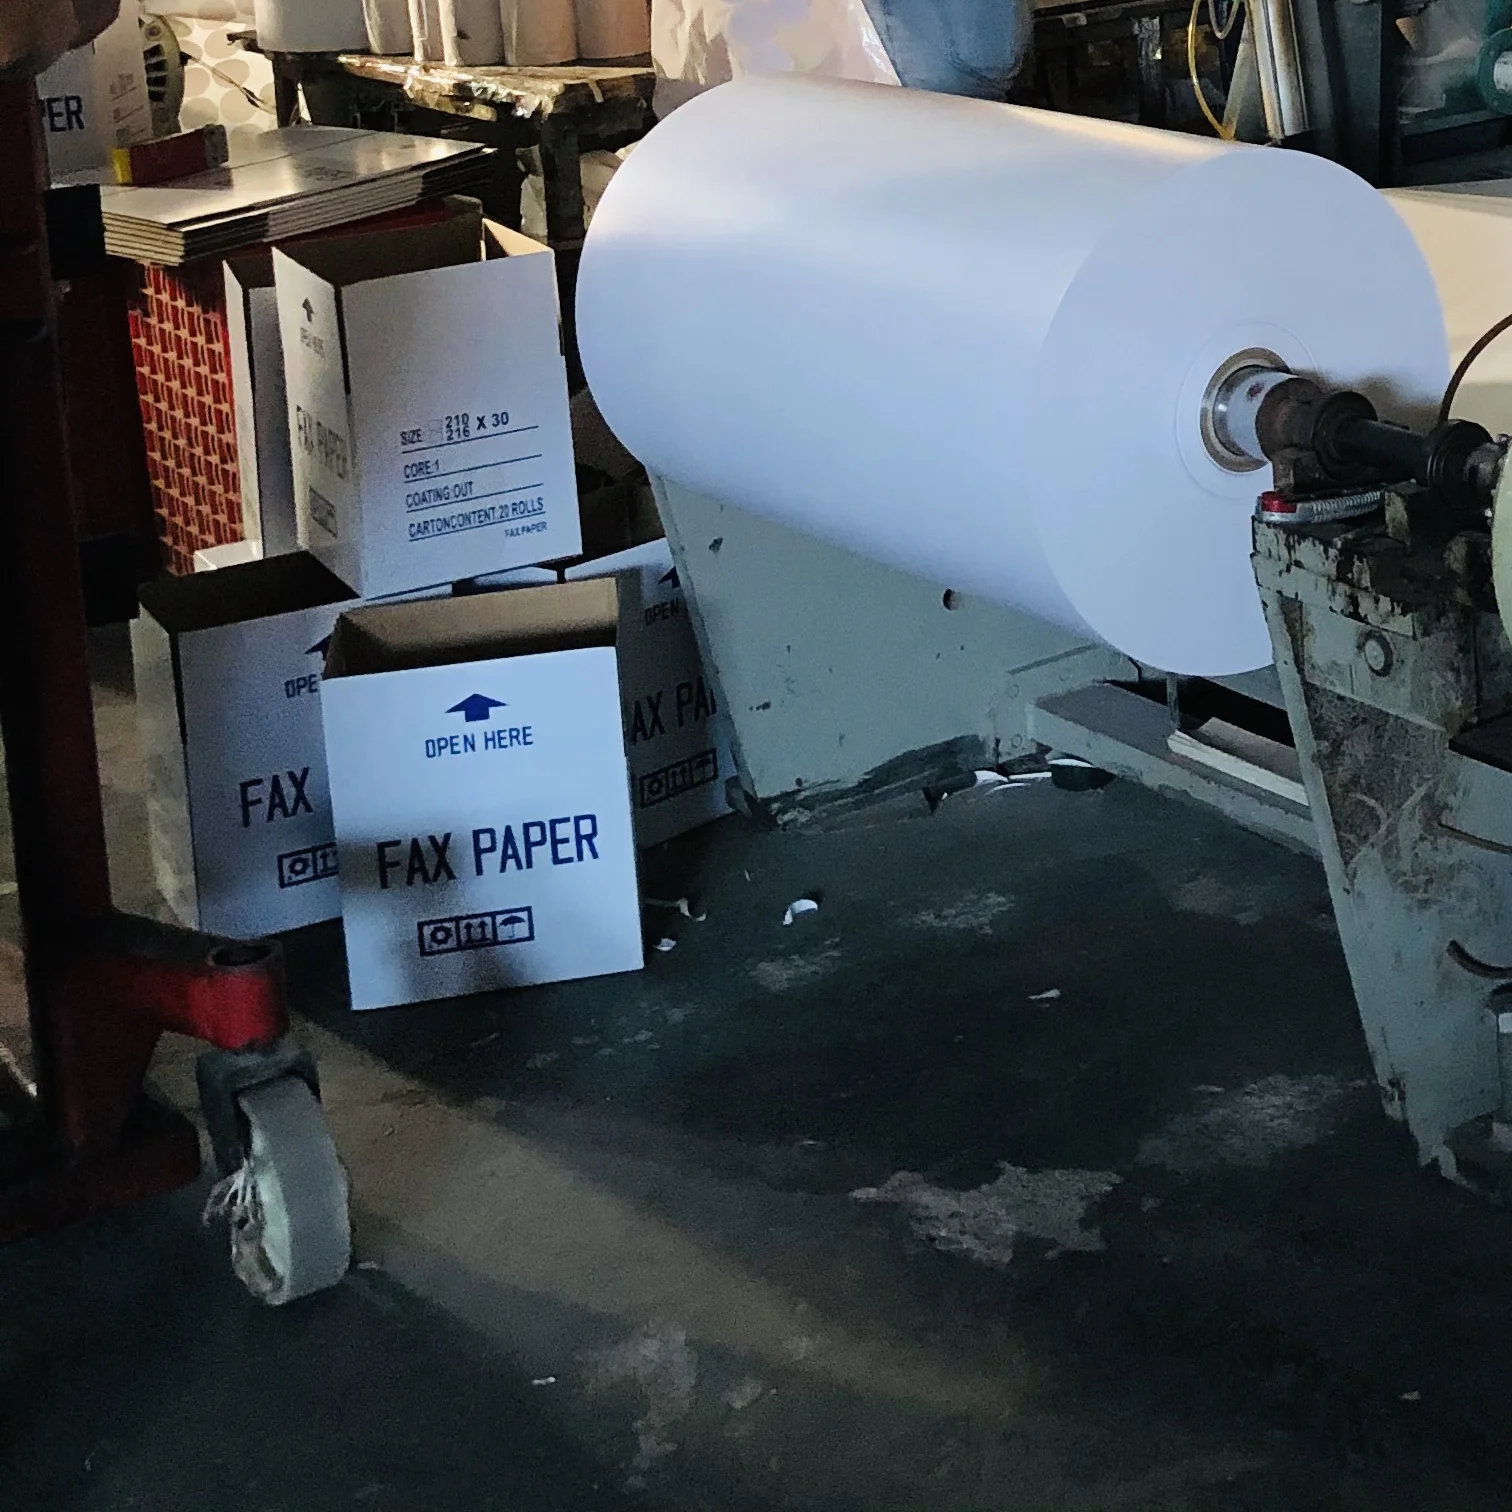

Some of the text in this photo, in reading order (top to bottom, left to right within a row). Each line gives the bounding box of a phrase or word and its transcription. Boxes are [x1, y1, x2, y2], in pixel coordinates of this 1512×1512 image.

[445, 413, 470, 429] 210
[446, 426, 471, 441] 216
[491, 411, 509, 427] 30
[512, 497, 544, 516] ROLLS
[521, 521, 548, 535] PAPER
[284, 673, 319, 699] OPE
[631, 675, 717, 745] AX PA
[425, 725, 534, 759] OPEN HERE
[239, 766, 314, 828] FAX
[377, 812, 600, 889] FAX PAPER
